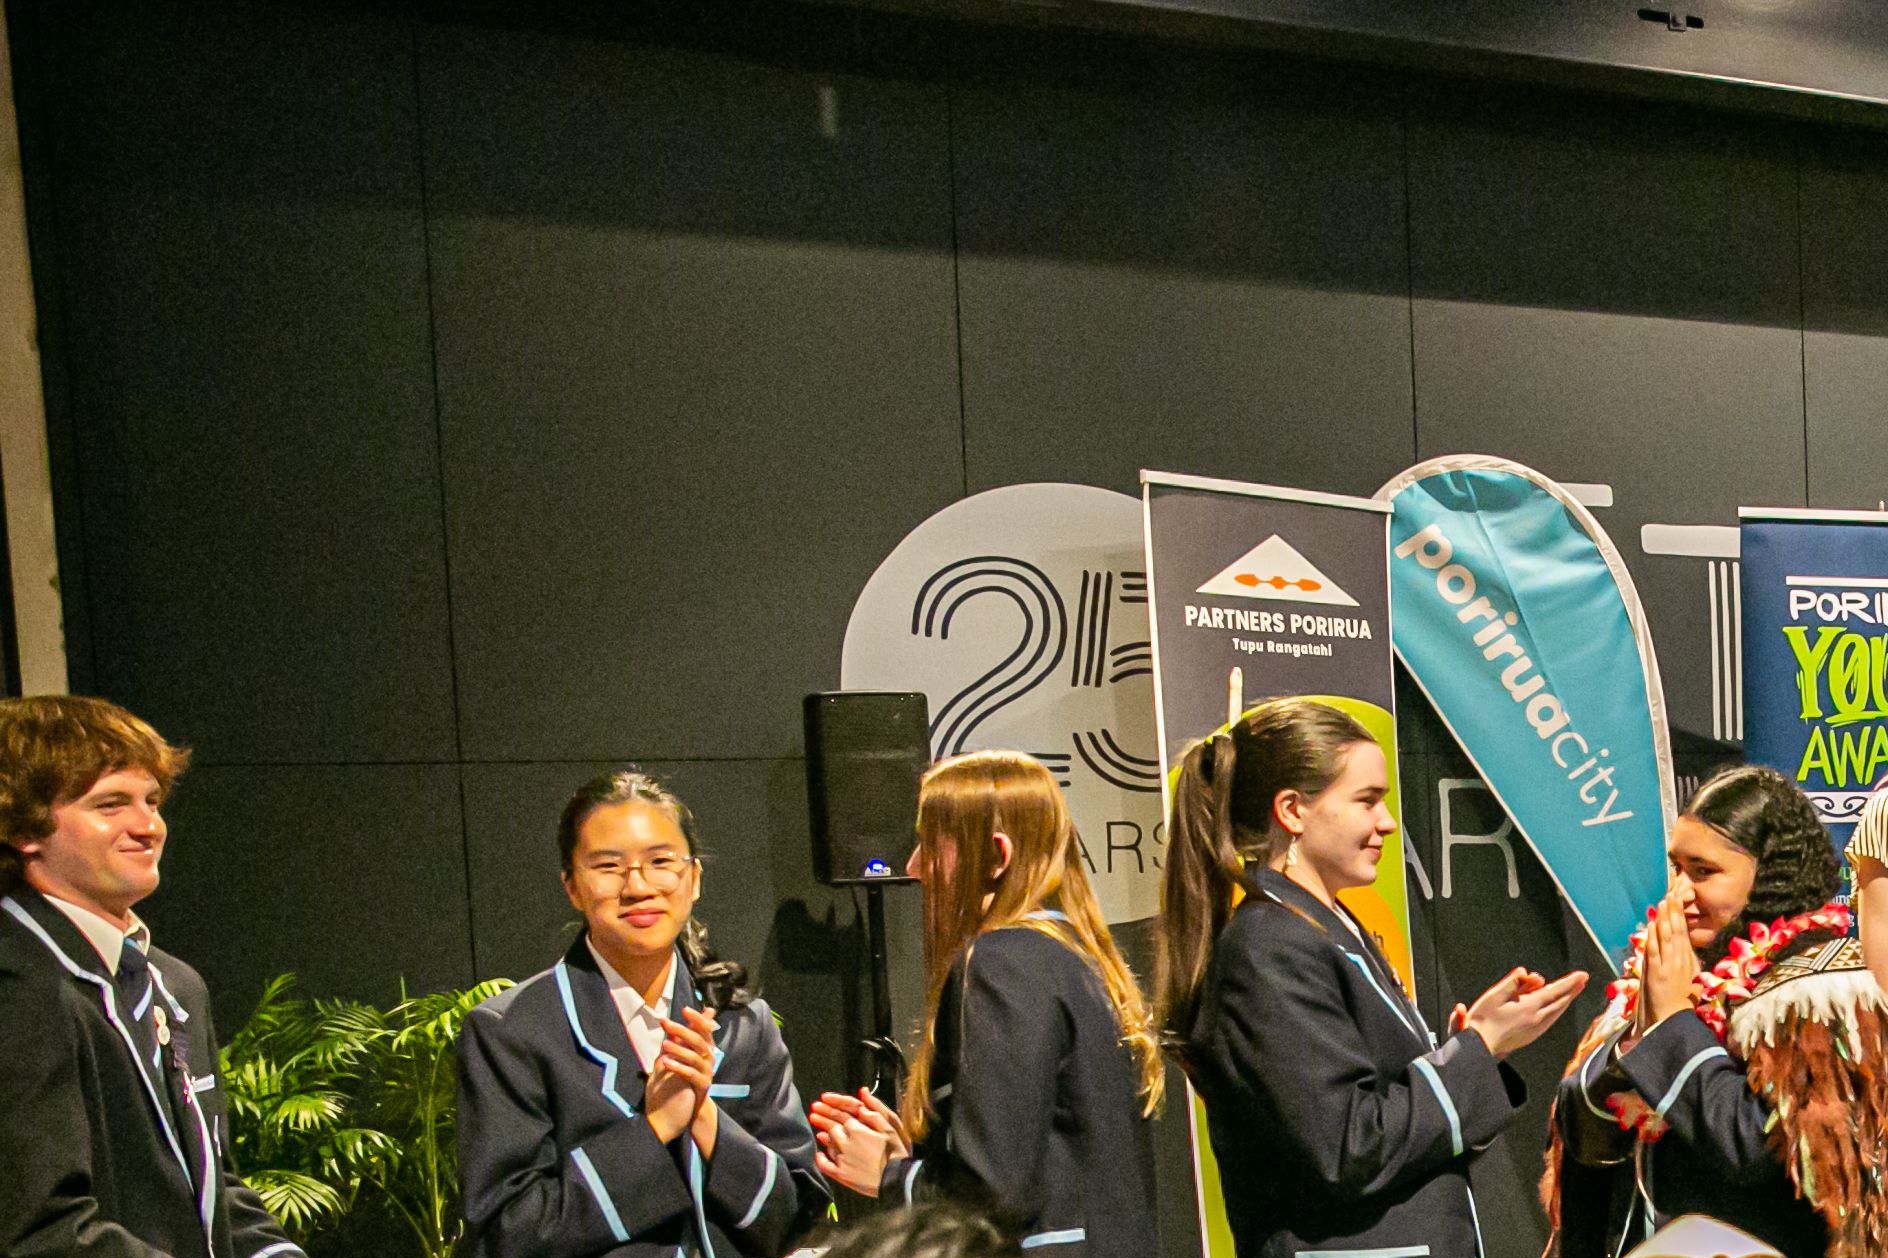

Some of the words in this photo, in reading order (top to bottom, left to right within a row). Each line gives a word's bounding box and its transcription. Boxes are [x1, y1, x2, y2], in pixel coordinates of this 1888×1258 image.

[1184, 605, 1286, 634] PARTNERS
[1290, 613, 1373, 640] PORIRUA
[1232, 637, 1264, 655] Tupu
[1267, 640, 1332, 658] Rangatahi
[1394, 523, 1635, 828] poriruacity
